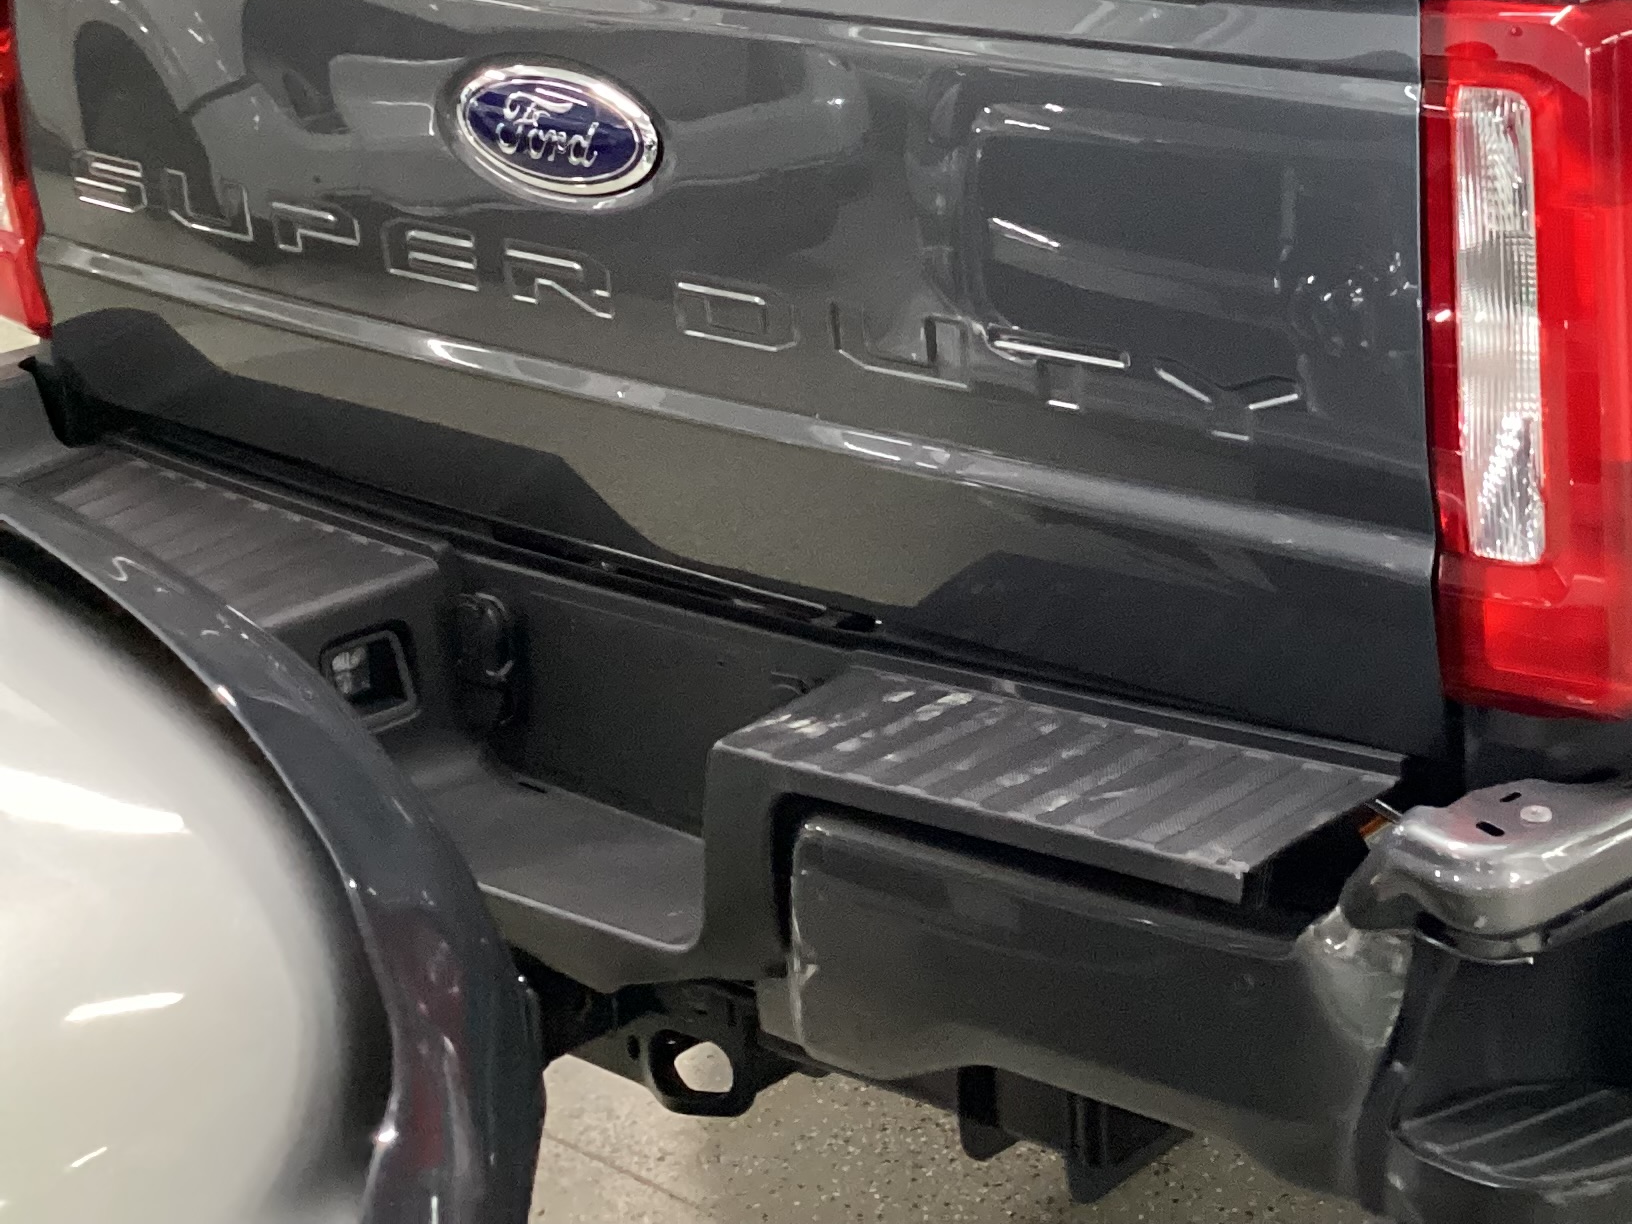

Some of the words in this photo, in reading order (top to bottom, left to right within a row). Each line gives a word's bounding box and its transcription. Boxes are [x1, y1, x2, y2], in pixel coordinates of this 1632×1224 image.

[496, 91, 599, 168] Ford
[73, 149, 615, 320] SUPER
[673, 271, 1300, 442] DUTY
